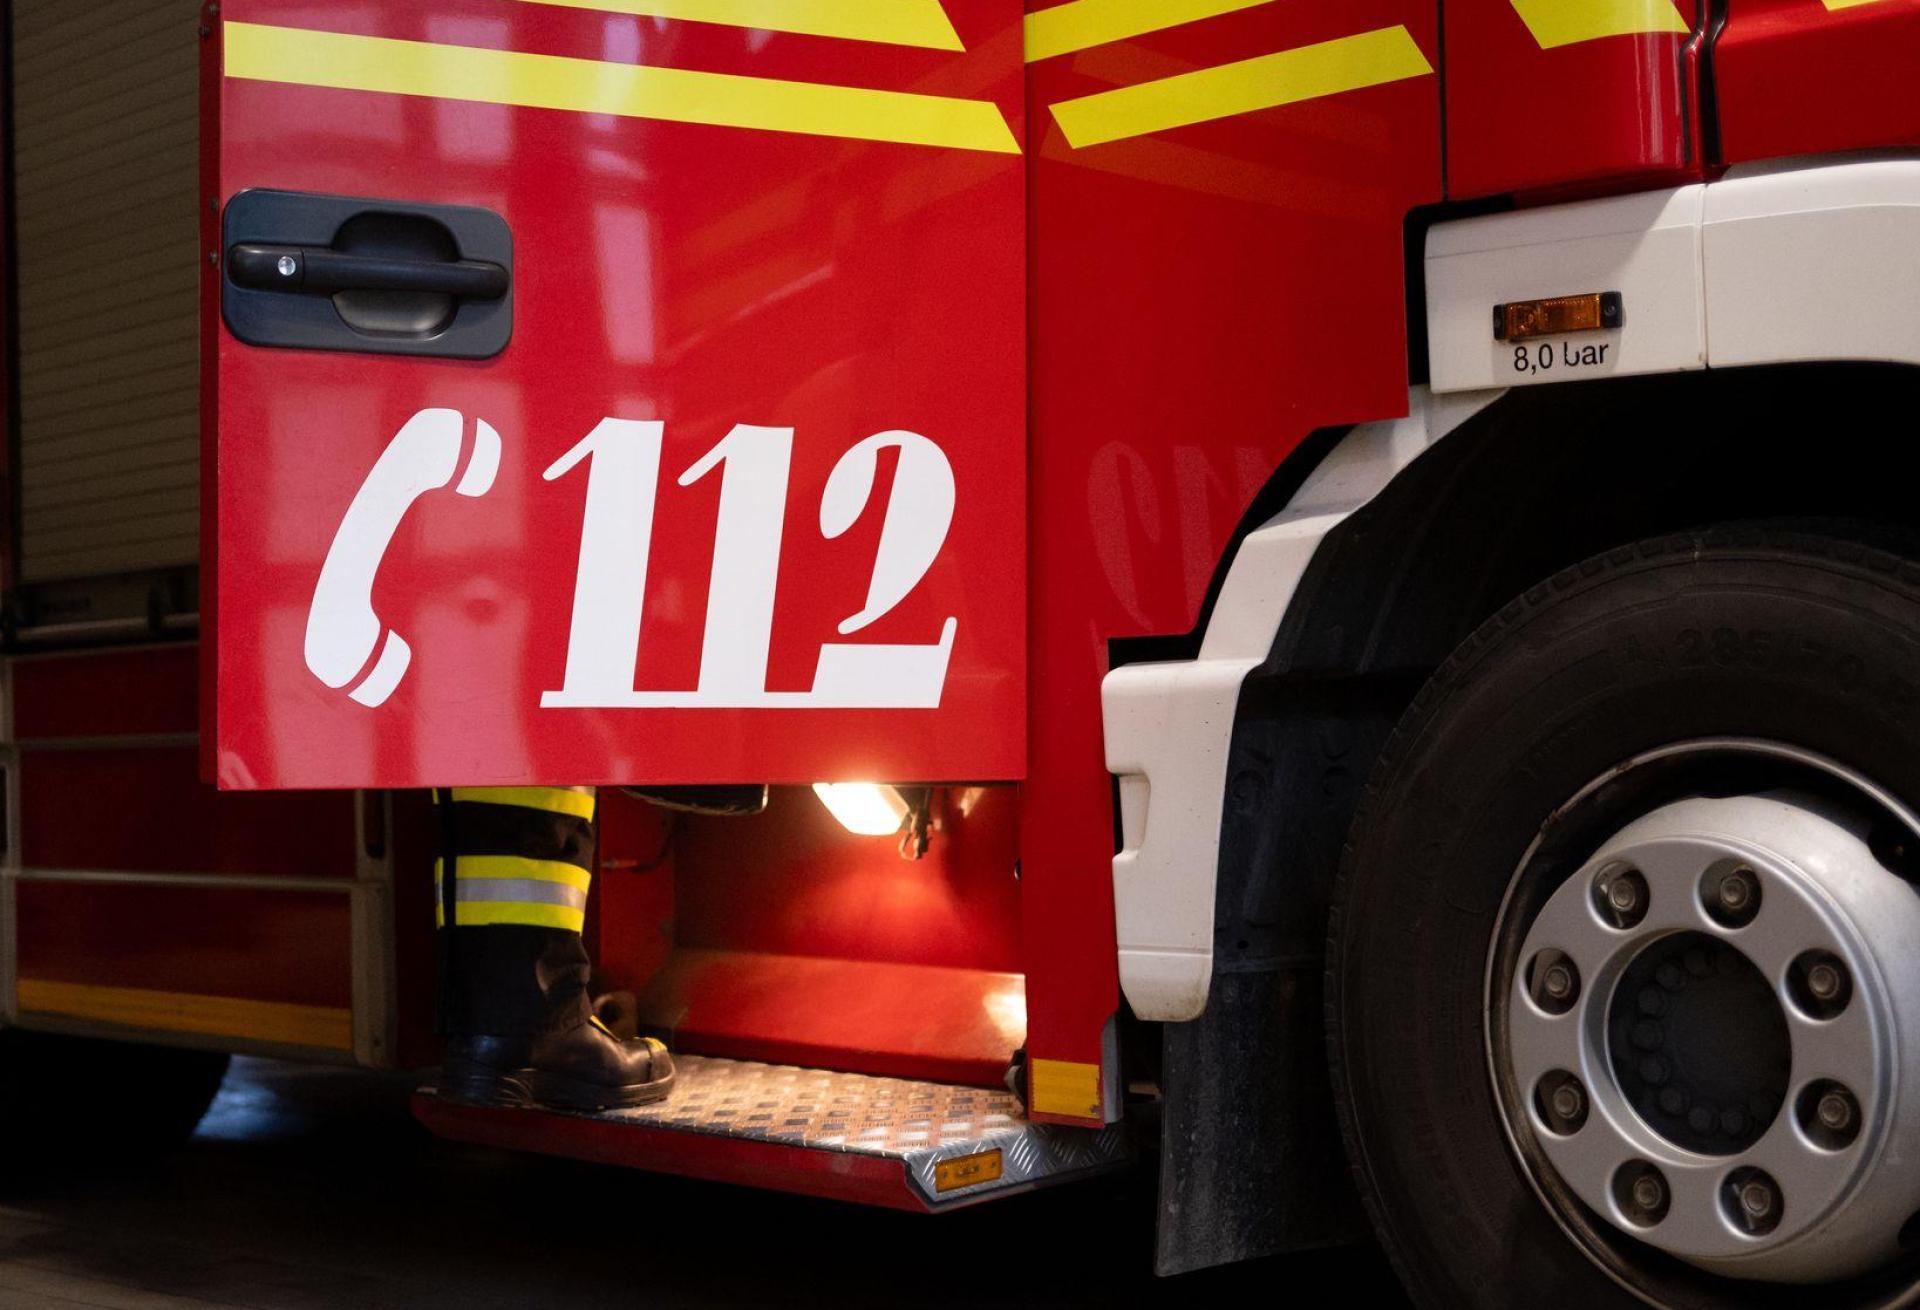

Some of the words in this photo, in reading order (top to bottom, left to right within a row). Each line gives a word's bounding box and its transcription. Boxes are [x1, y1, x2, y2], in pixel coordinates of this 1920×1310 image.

[1514, 344, 1553, 375] 8,0
[1564, 341, 1609, 367] bar
[540, 416, 958, 709] 112
